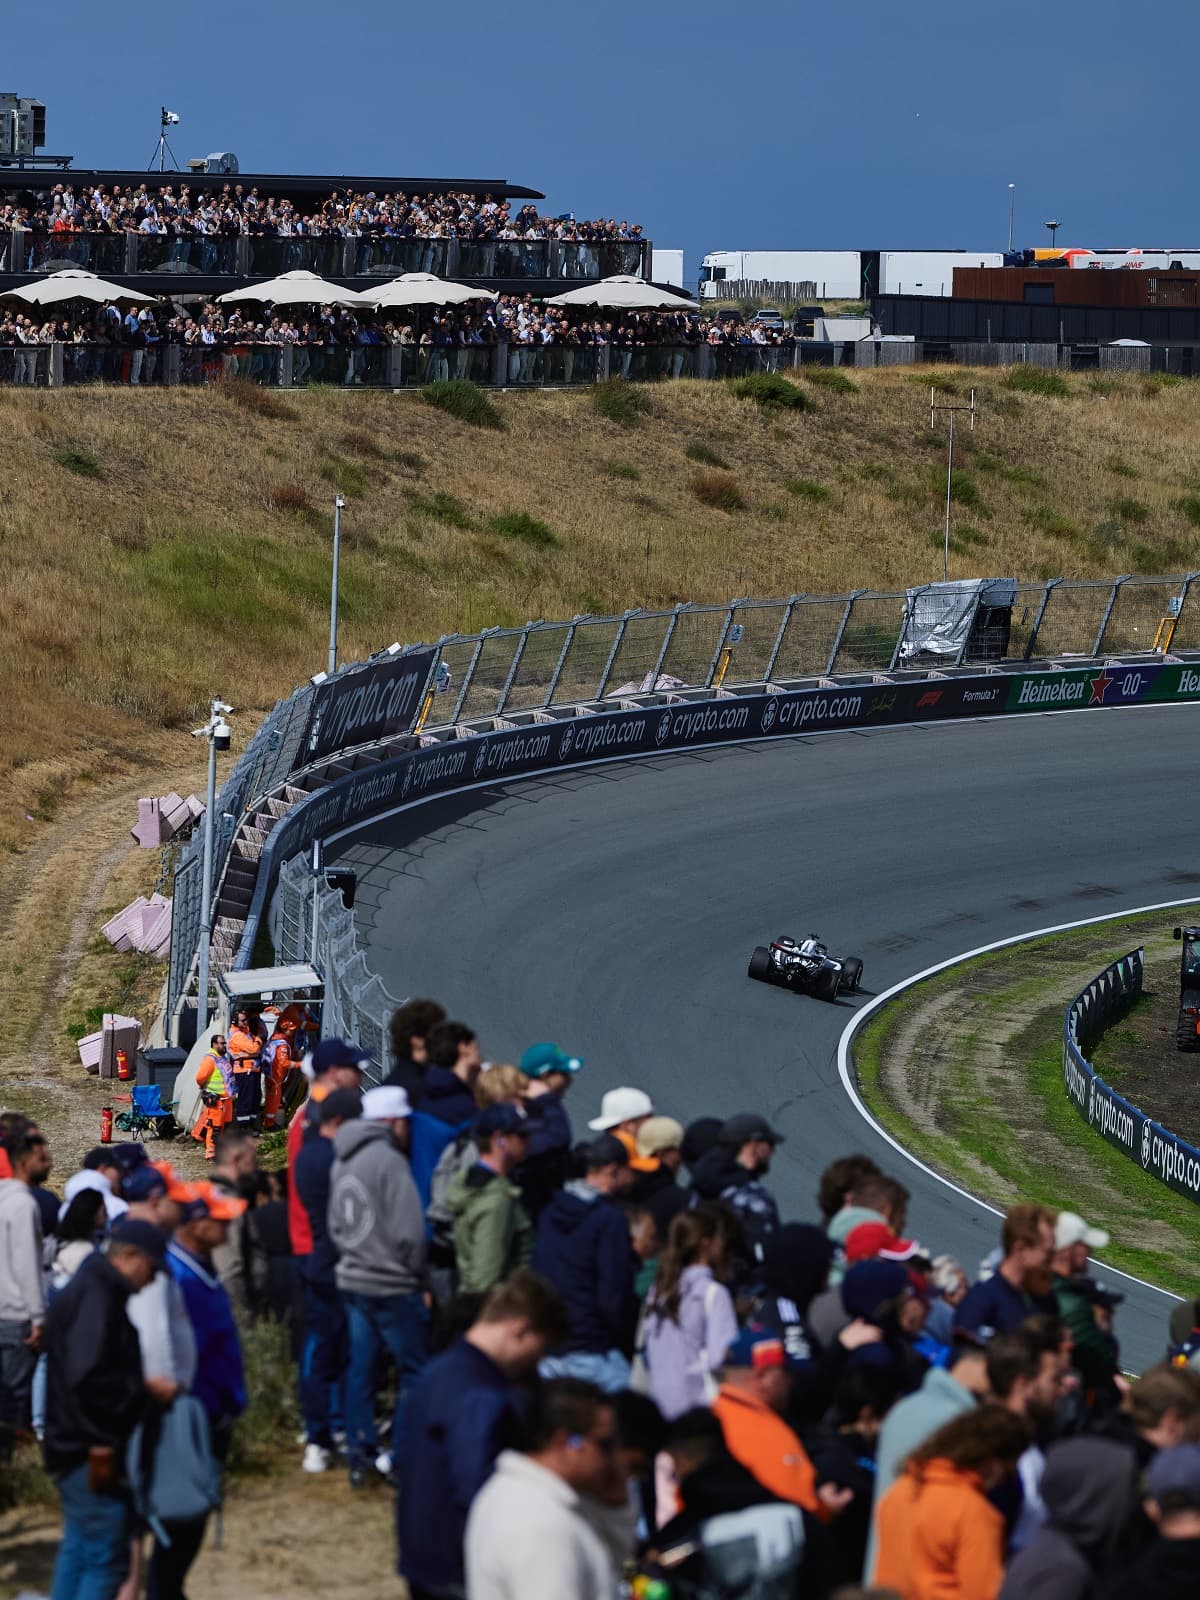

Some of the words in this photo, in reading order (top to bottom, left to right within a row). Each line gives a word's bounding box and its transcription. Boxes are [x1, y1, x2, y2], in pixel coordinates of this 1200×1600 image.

[962, 689, 991, 702] Formula
[1018, 678, 1085, 704] Heineken
[673, 707, 749, 739] crypto.com
[779, 696, 862, 727] crypto.com
[488, 735, 550, 770] crypto.com
[575, 719, 646, 753] crypto.com
[413, 752, 467, 789] crypto.com
[1095, 1092, 1134, 1149] crypto.com
